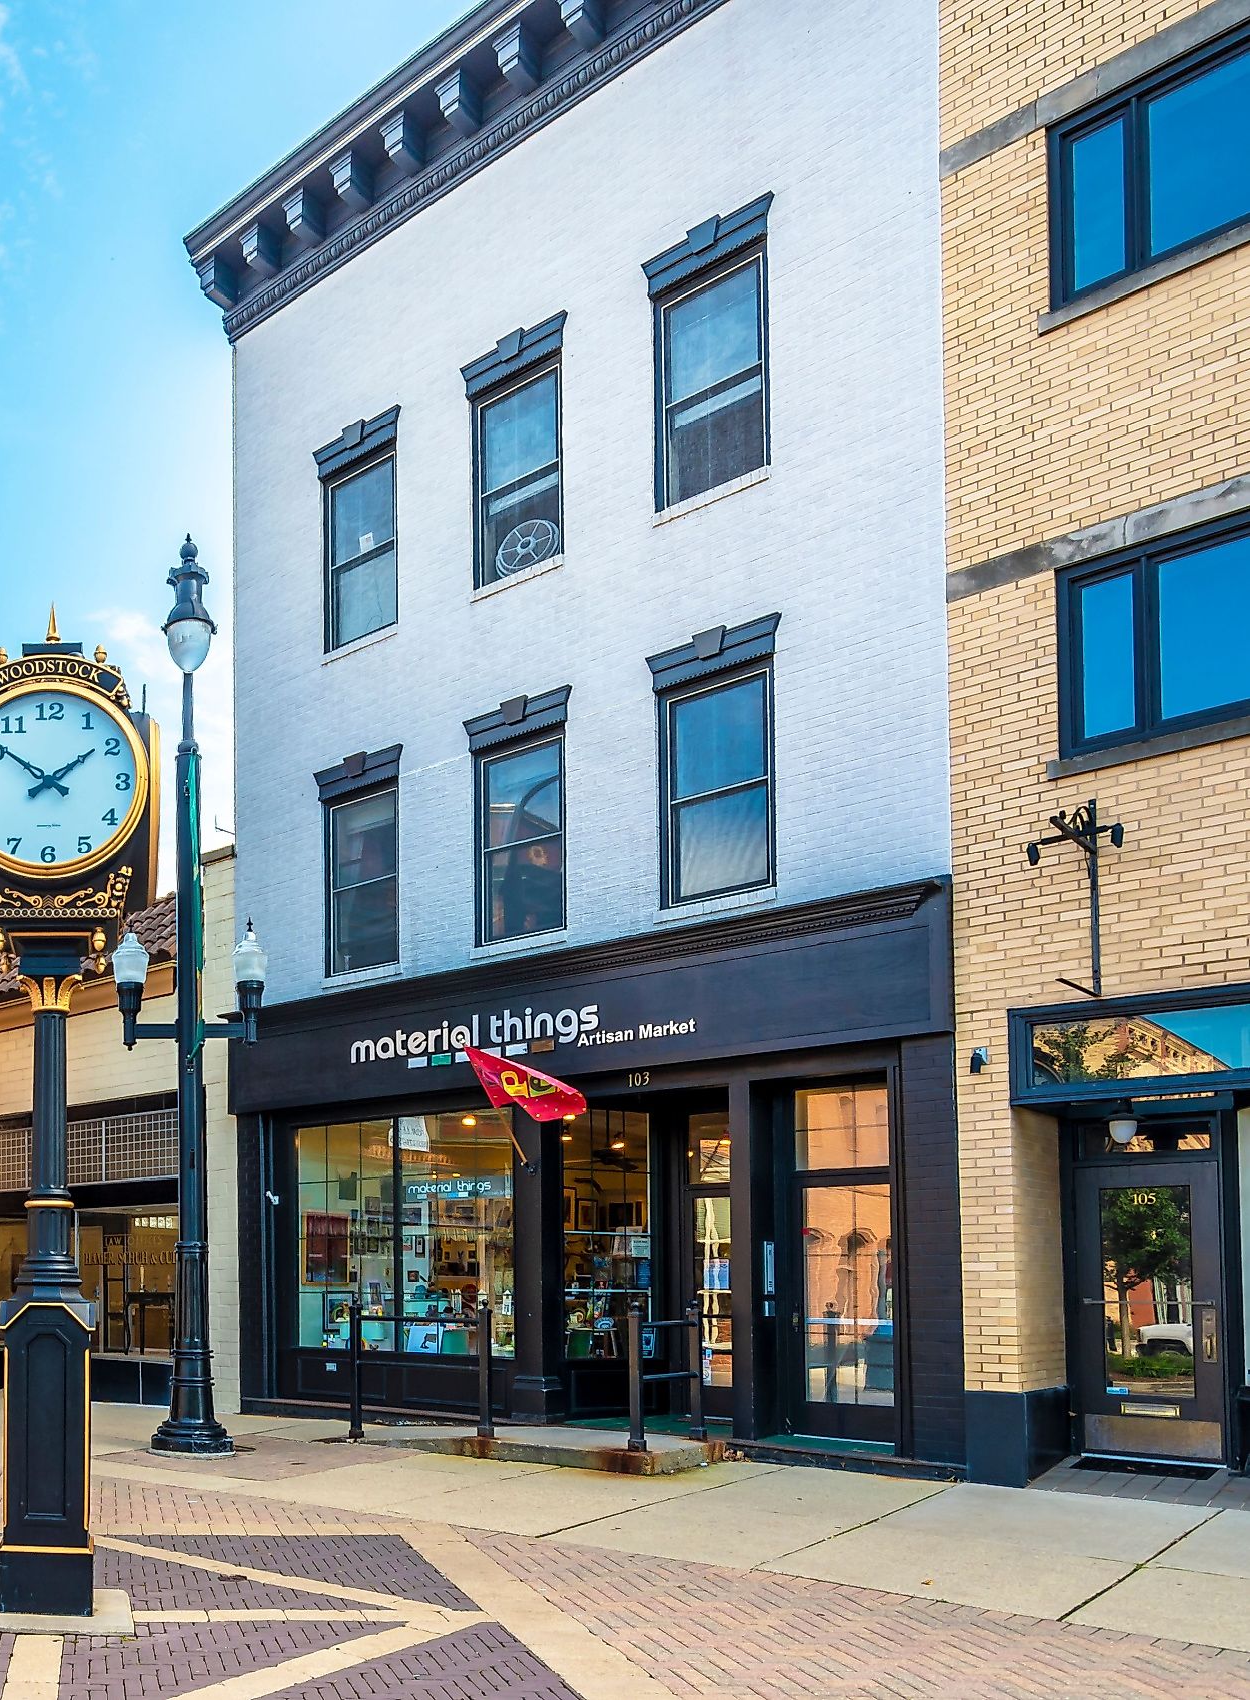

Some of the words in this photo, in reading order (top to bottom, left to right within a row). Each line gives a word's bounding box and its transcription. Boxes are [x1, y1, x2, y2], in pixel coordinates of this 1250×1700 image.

[35, 702, 65, 721] 12
[0, 715, 27, 734] 11
[81, 712, 95, 730] 1
[104, 737, 121, 756] 2
[115, 772, 131, 791] 3
[101, 808, 119, 826] 4
[6, 837, 23, 855] 7
[40, 845, 56, 863] 6
[77, 836, 92, 854] 5
[350, 1014, 479, 1064] material
[489, 1003, 599, 1044] things
[576, 1030, 634, 1048] Artisan
[638, 1017, 696, 1039] Market
[627, 1071, 651, 1089] 103
[1132, 1193, 1156, 1205] 105
